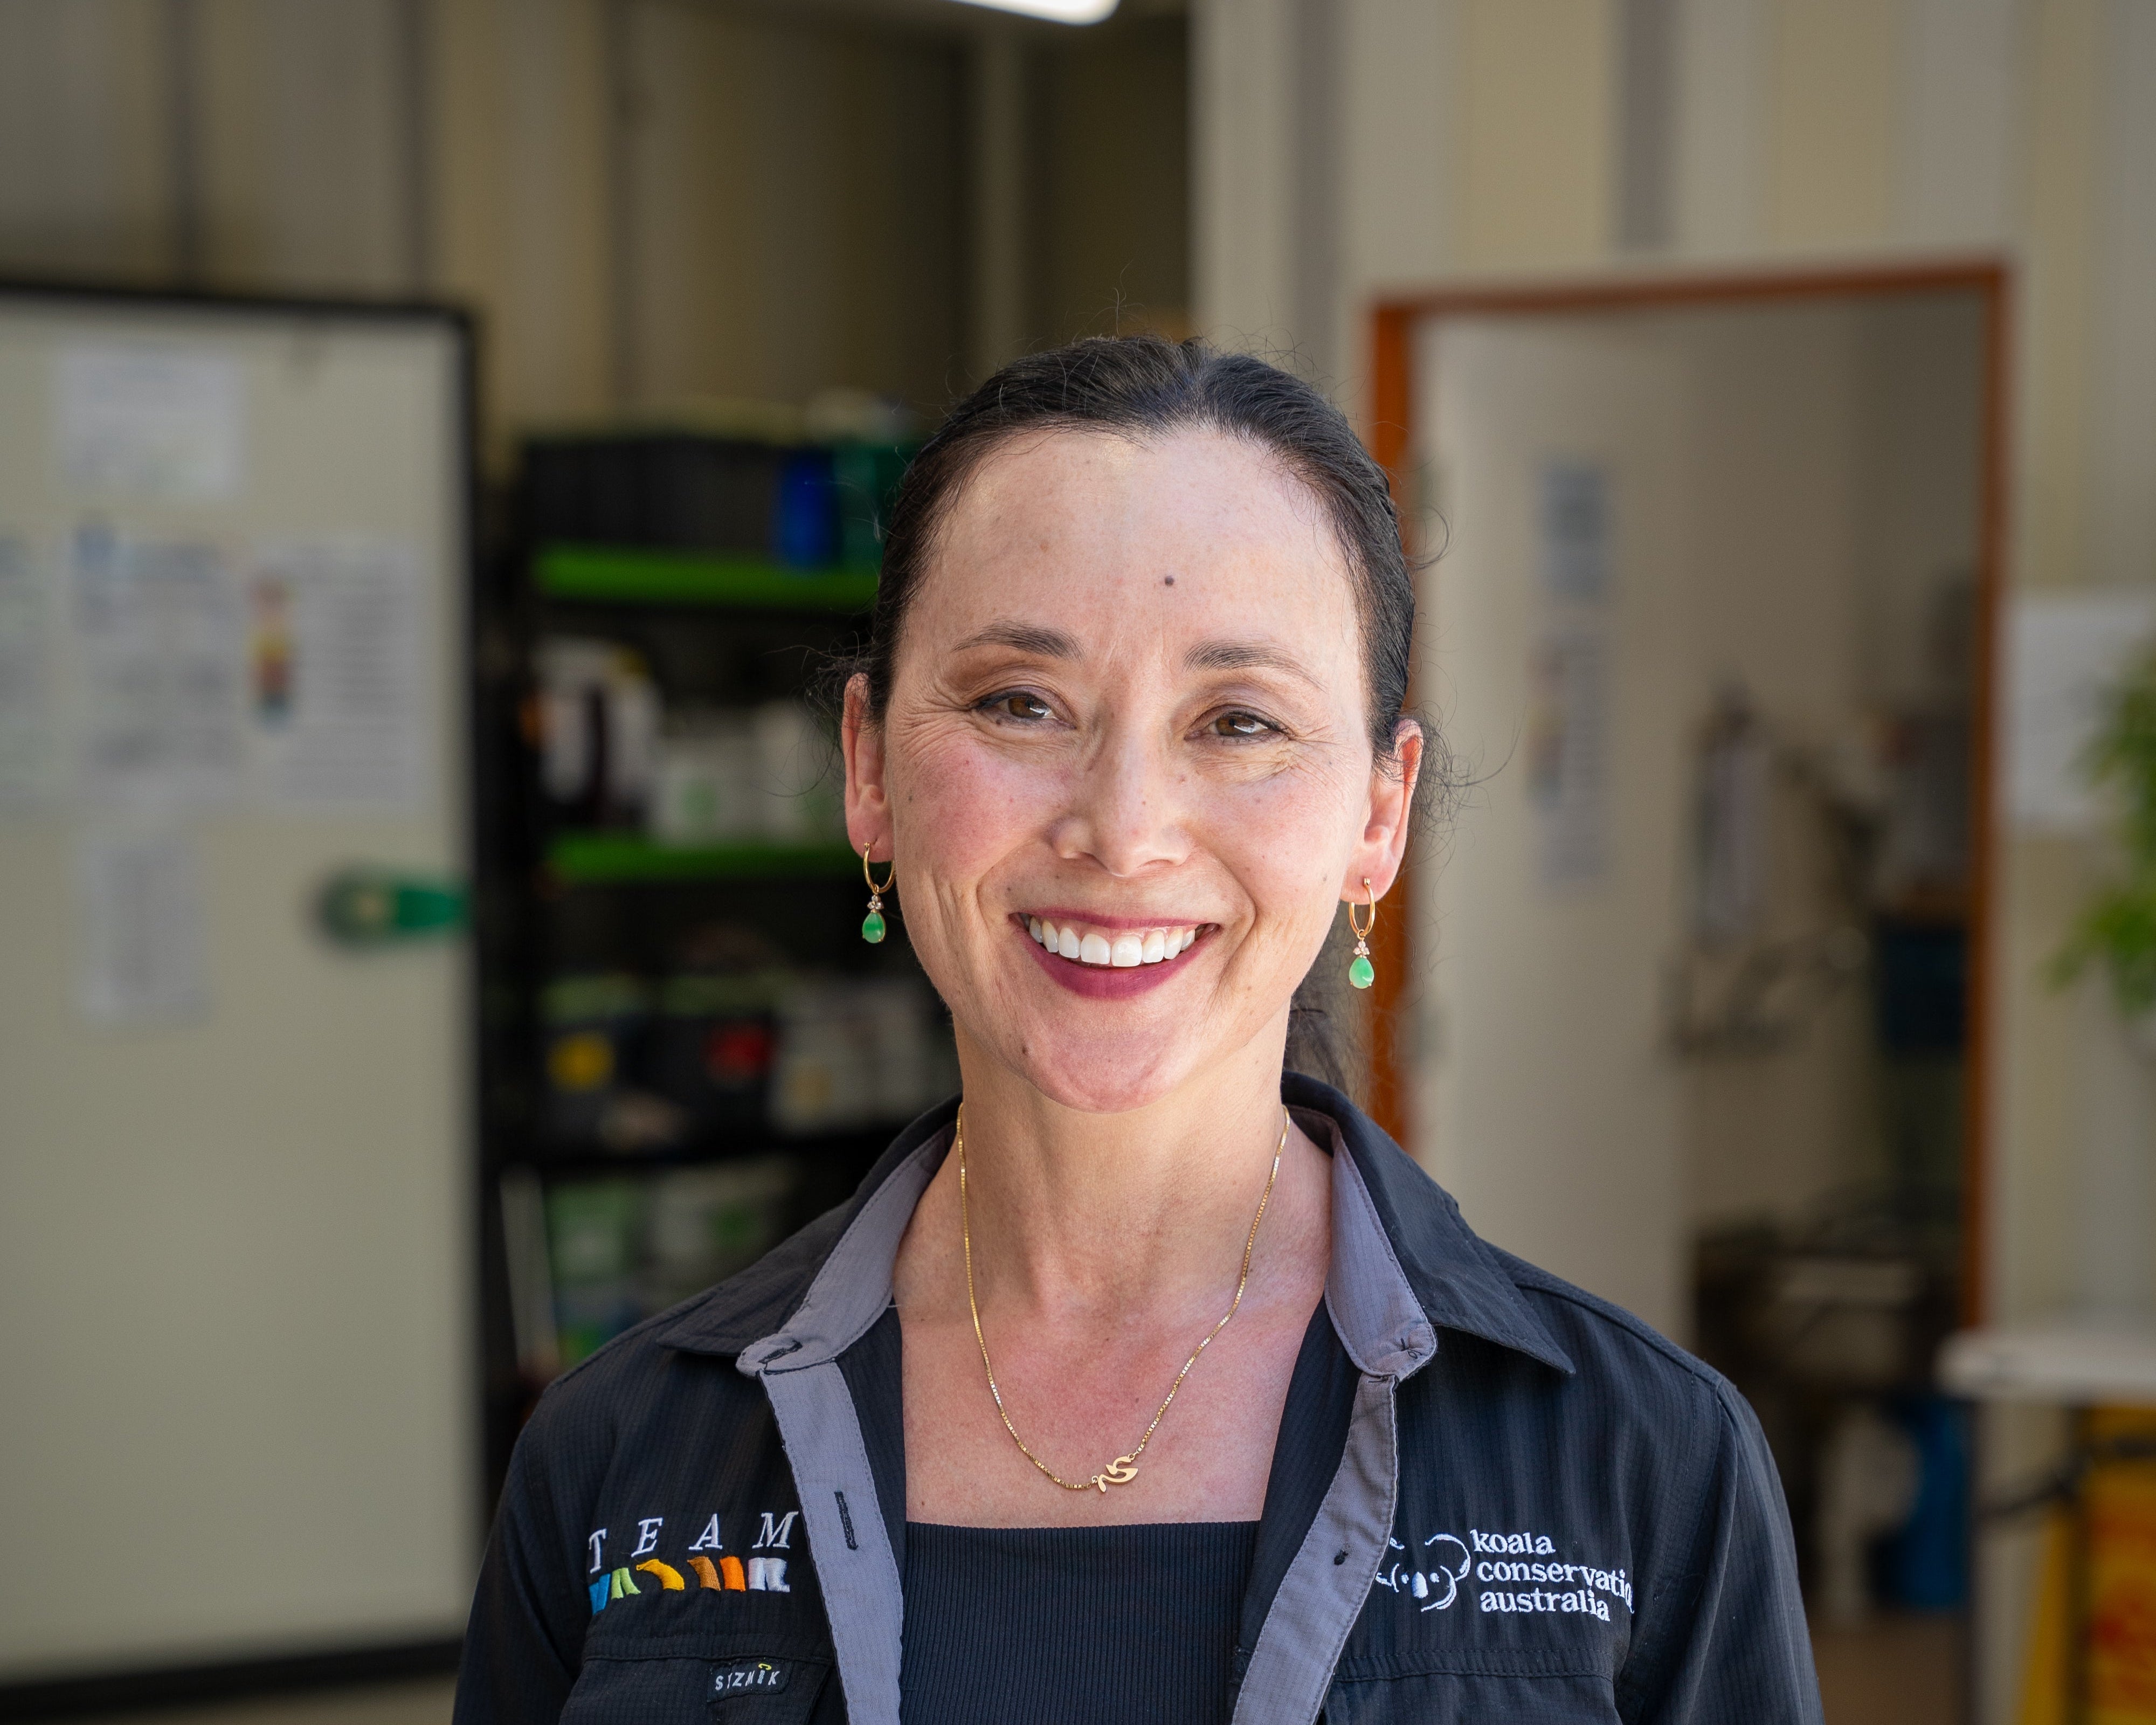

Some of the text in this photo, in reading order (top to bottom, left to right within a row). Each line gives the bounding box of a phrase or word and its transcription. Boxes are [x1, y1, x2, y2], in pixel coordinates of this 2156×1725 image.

[589, 1510, 799, 1574] TEAM
[1470, 1529, 1556, 1555] koala
[1476, 1561, 1634, 1614] conservatio
[1480, 1588, 1611, 1622] australia
